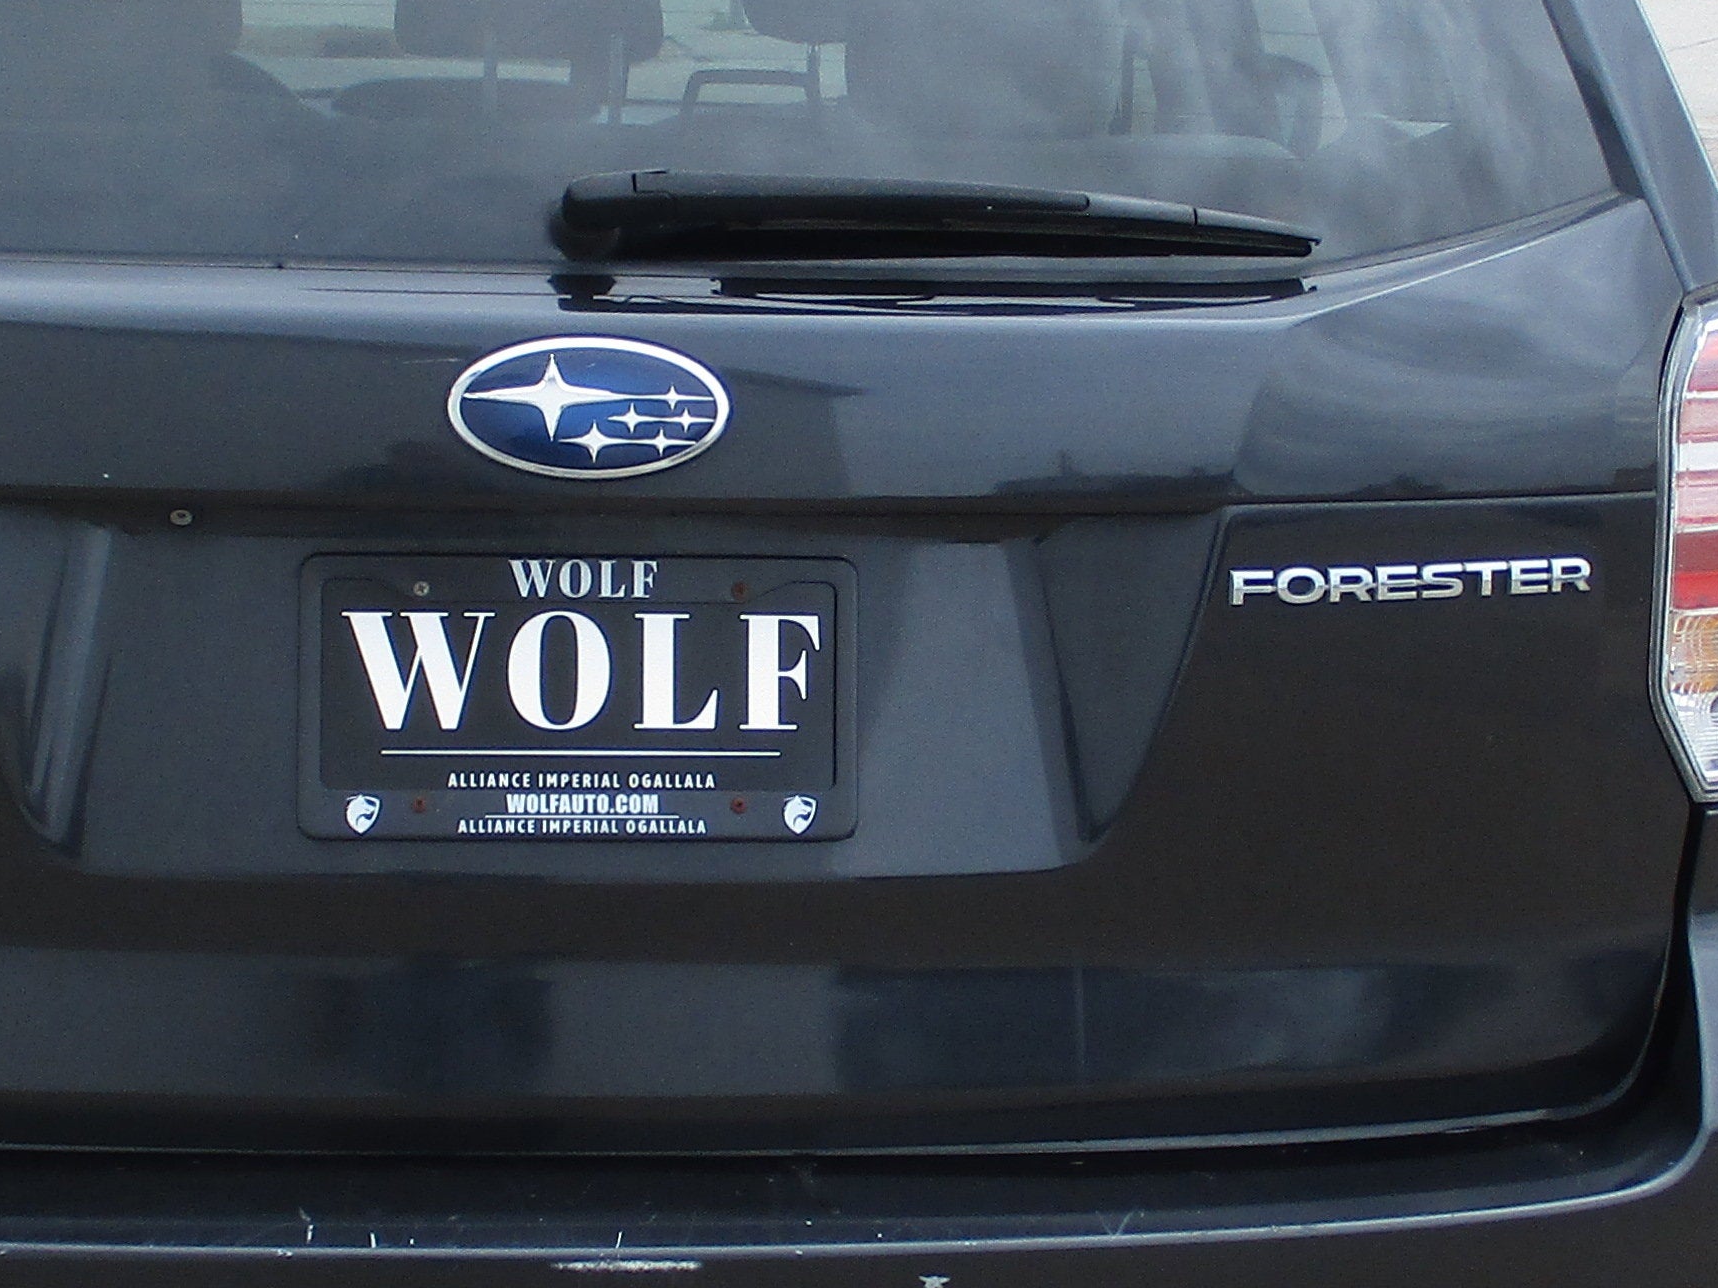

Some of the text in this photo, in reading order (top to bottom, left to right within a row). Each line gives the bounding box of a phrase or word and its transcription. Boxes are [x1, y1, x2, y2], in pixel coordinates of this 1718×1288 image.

[508, 558, 661, 600] WOLF
[1228, 557, 1592, 606] FORESTER
[340, 609, 822, 732] WOLF
[447, 772, 716, 789] ALLIANCE IMPERIAL OGALLALA
[505, 792, 660, 815] WOLFAUTO.COM
[457, 818, 708, 835] ALLIANCE IMPERIAL OGALLALA
